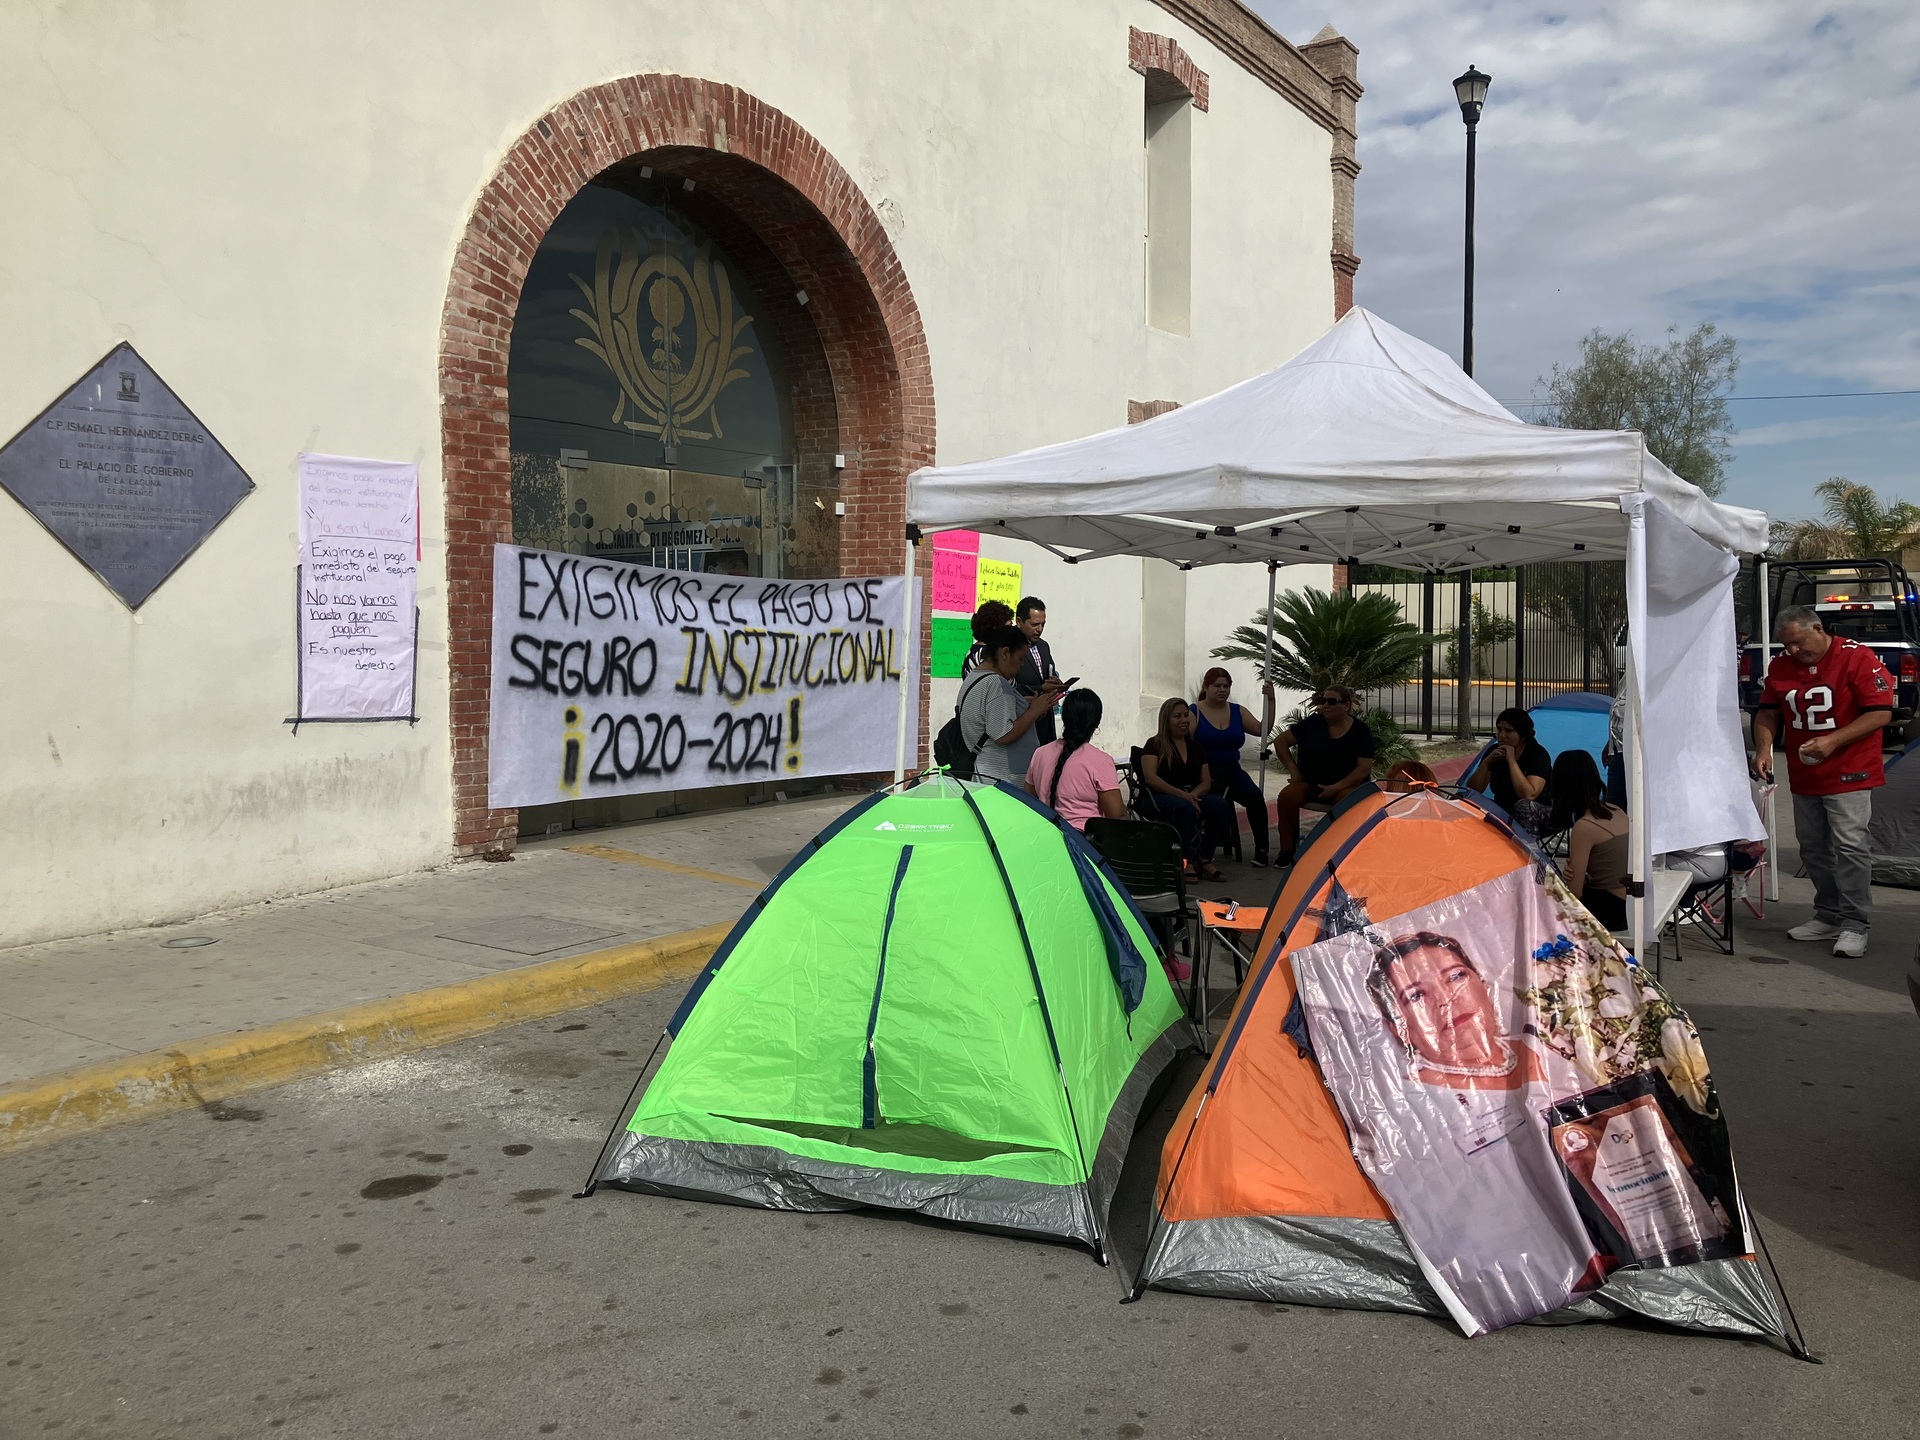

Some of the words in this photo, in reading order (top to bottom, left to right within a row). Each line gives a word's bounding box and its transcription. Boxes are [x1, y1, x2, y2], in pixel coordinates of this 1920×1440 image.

[47, 420, 65, 431] C.P.
[67, 421, 106, 435] ISMAEL
[107, 425, 169, 440] HERNÁNDEZ
[172, 431, 204, 444] DERAS
[149, 448, 177, 456] DURANGO
[59, 458, 72, 470] EL
[76, 460, 121, 473] PALACIO
[125, 463, 139, 474] DE
[143, 465, 194, 478] GOBIERNO
[98, 476, 109, 484] DE
[114, 477, 125, 485] LA
[129, 477, 162, 487] LAGUNA
[107, 487, 116, 495] DE
[119, 488, 154, 498] DURANGO
[316, 515, 331, 534] Ya
[336, 524, 359, 534] son
[363, 520, 371, 536] 4
[375, 527, 402, 538] años
[651, 532, 660, 547] 01
[662, 531, 672, 546] DE
[674, 527, 702, 546] GÓMEZ
[311, 540, 366, 563] Exigimos
[368, 547, 379, 560] el
[383, 553, 406, 566] pago
[314, 568, 367, 582] institucional
[366, 561, 380, 573] del
[386, 566, 417, 578] seguro
[306, 588, 328, 606] No
[333, 594, 357, 605] nos
[518, 552, 702, 626] EXIGIMOS
[708, 583, 747, 626] EL
[758, 582, 832, 627] PAGO
[844, 579, 884, 626] DE
[310, 608, 342, 620] hasta
[348, 611, 370, 626] que
[373, 610, 395, 621] nos
[332, 625, 371, 640] paguen
[308, 641, 329, 655] Es
[333, 642, 377, 656] nuestro
[355, 659, 396, 671] derecho
[509, 633, 657, 698] SEGURO
[675, 626, 901, 704] INSTITUCIONAL
[1785, 685, 1836, 731] 12
